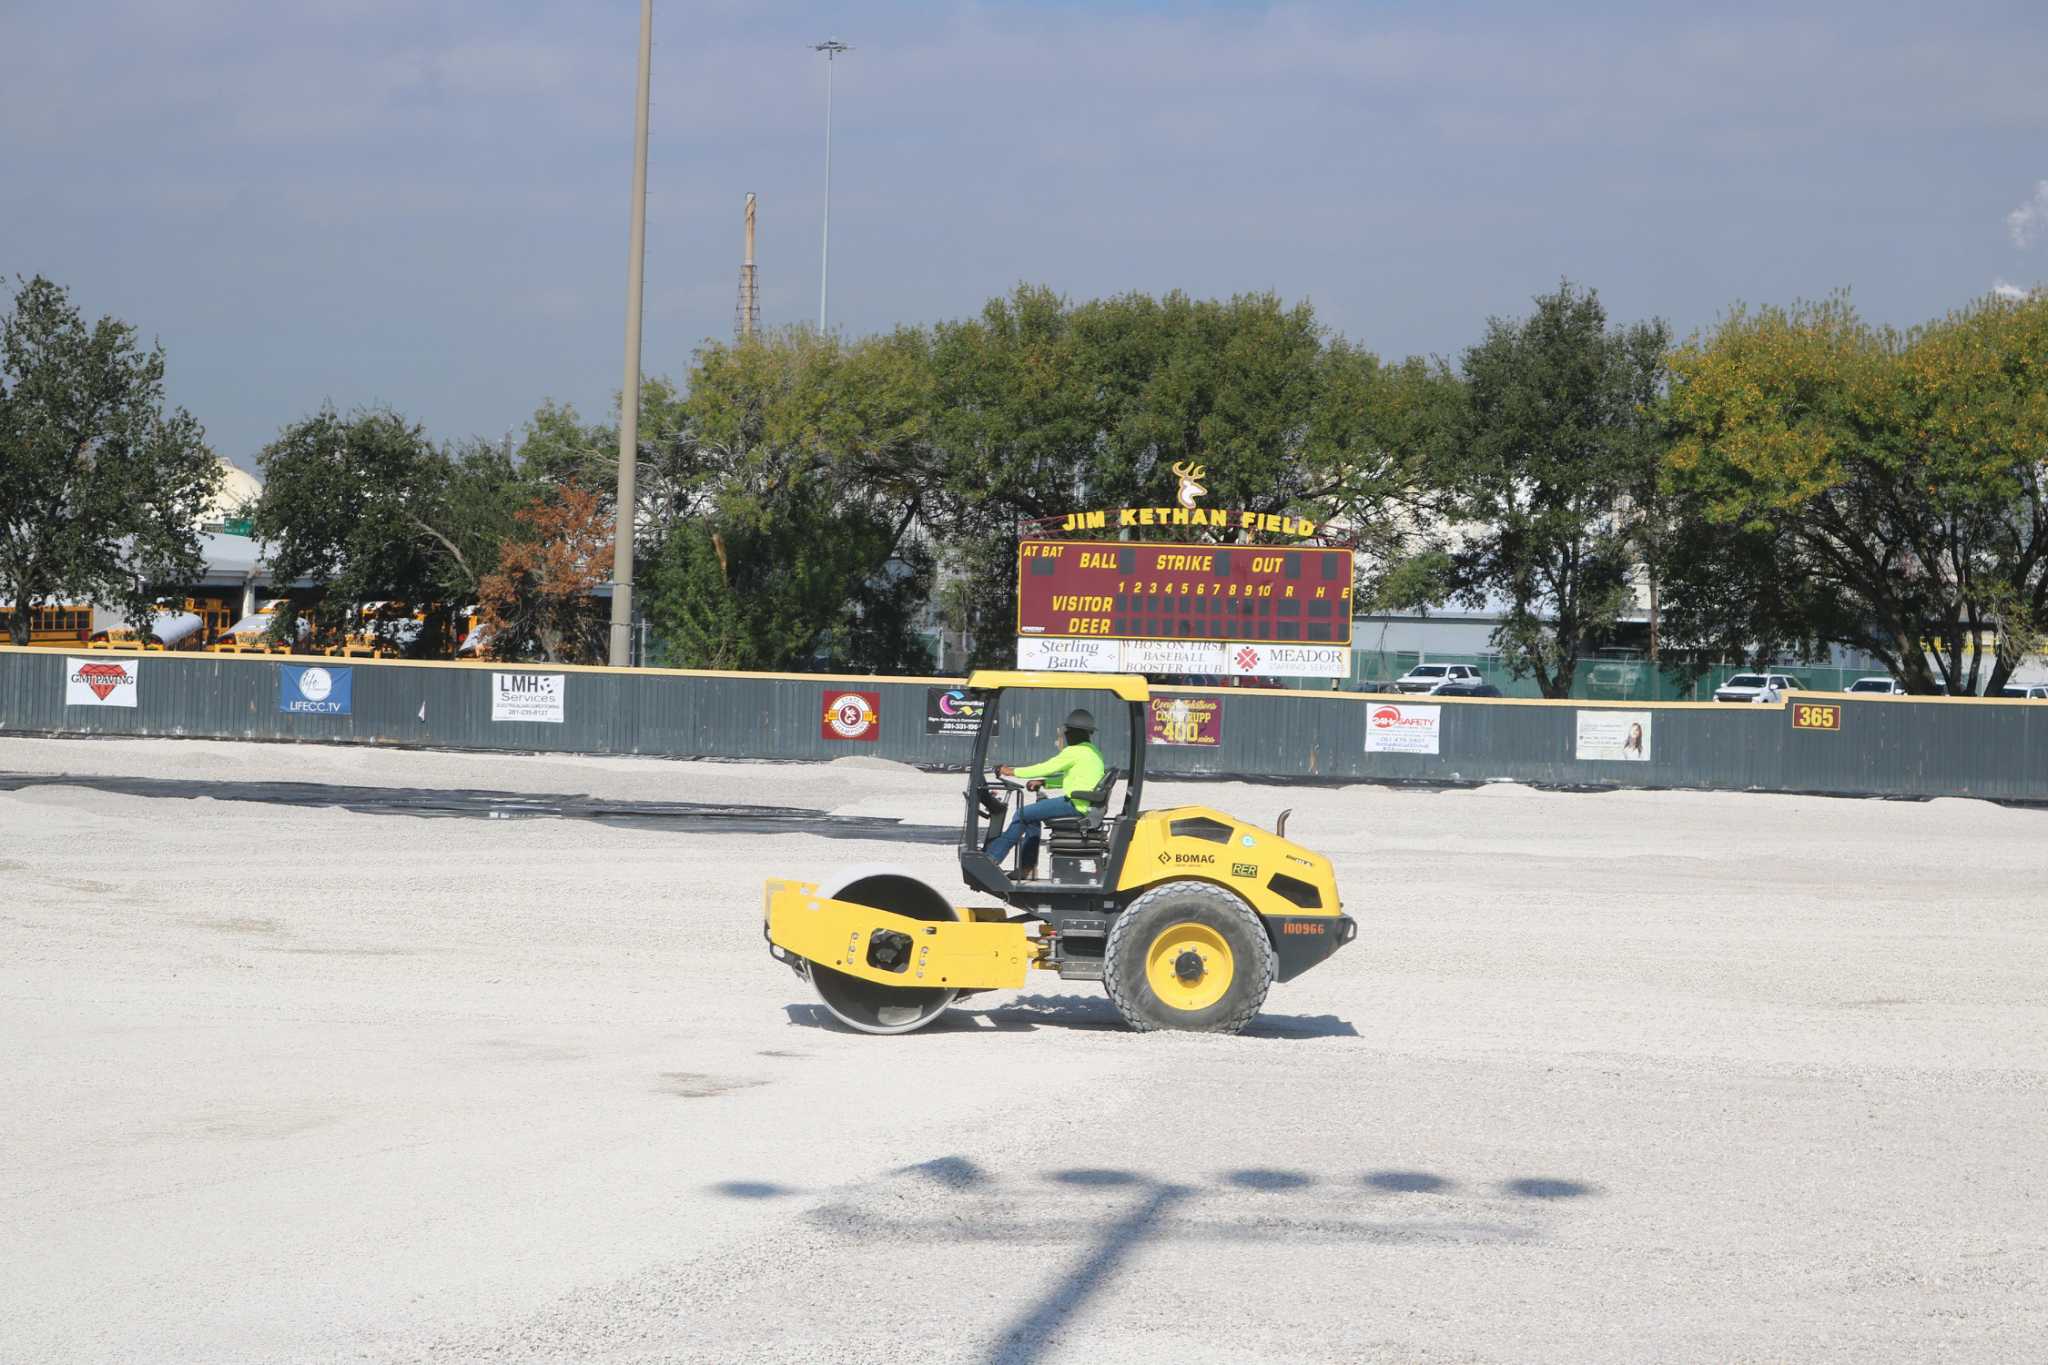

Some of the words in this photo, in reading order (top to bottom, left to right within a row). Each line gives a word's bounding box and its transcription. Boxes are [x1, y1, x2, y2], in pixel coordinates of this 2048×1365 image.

[1062, 511, 1105, 531] JIM
[1120, 508, 1227, 527] KETHAN
[1242, 511, 1315, 537] FIELD
[1024, 546, 1038, 557] AT
[1042, 546, 1064, 558] BAT
[1080, 553, 1117, 569] BALL
[1156, 555, 1213, 571] STRIKE
[1252, 557, 1284, 573] OUT
[1119, 582, 1126, 593] 1
[1133, 582, 1142, 593] 2
[1149, 582, 1157, 594] 3
[1165, 583, 1173, 594] 4
[1181, 583, 1189, 595] 5
[1196, 584, 1205, 595] 6
[1212, 584, 1220, 595] 7
[1229, 584, 1237, 596] 8
[1244, 585, 1252, 596] 9
[1258, 585, 1271, 597] 10
[1285, 586, 1294, 597] R
[1316, 587, 1325, 598] H
[1342, 587, 1350, 599] E
[1052, 596, 1113, 612] VISITOR
[1069, 618, 1111, 634] DEER
[1040, 640, 1099, 656] Sterling
[1167, 640, 1184, 649] ON
[1047, 655, 1088, 669] Bank
[1144, 651, 1204, 662] BASEBALL
[1269, 649, 1343, 663] MEADOR
[1126, 663, 1184, 673] BOOSTER
[1188, 664, 1223, 673] CLUB
[96, 675, 134, 685] PAVING
[501, 675, 538, 692] LMH
[501, 692, 556, 702] Services
[290, 701, 342, 713] LIFECC.TV
[1800, 706, 1834, 727] 365
[1163, 719, 1198, 742] 400
[1176, 854, 1215, 864] BOMAG
[1233, 864, 1257, 875] RER
